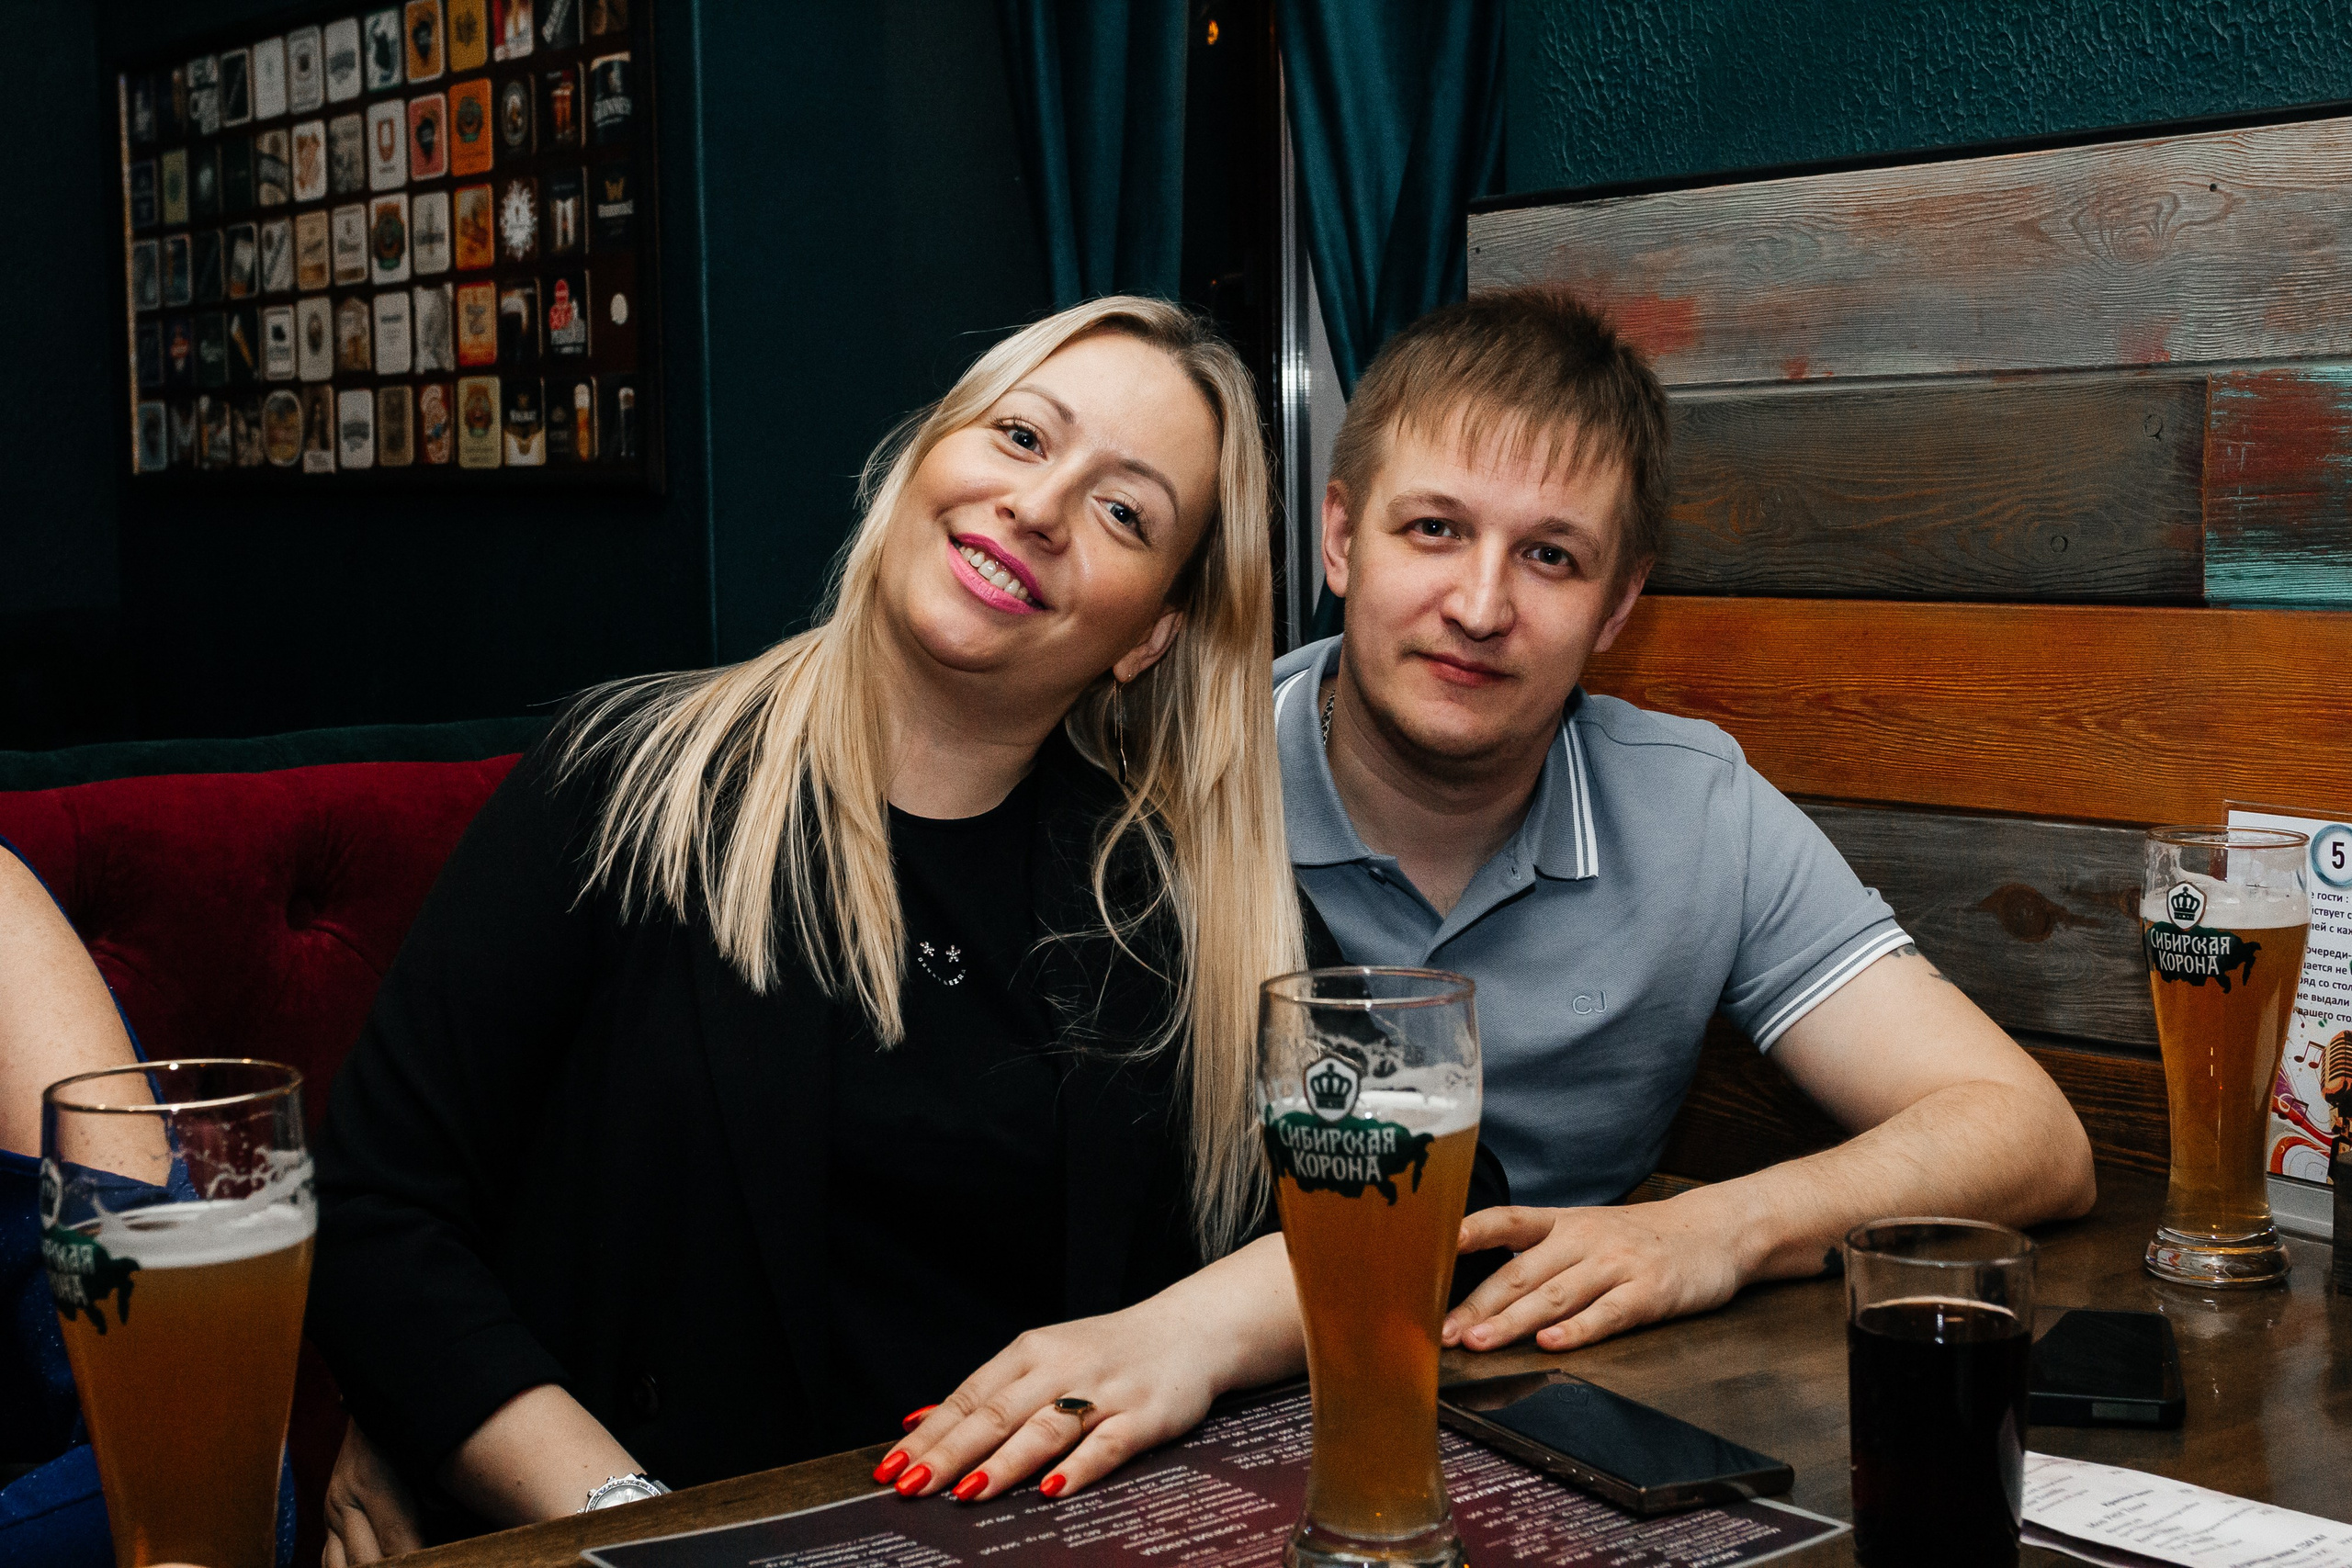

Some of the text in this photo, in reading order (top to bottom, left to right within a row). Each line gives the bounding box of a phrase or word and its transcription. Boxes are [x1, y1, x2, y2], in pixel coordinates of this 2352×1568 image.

[2332, 841, 2345, 869] 5
[2317, 893, 2343, 902] гости
[2151, 928, 2231, 955] СИБИРСКАЯ
[2158, 950, 2220, 976] КОРОНА
[2335, 966, 2347, 975] не
[2318, 979, 2330, 988] со
[1572, 991, 1608, 1015] CJ
[2297, 992, 2350, 1007] не выдали
[1278, 1119, 1396, 1156] СИБИРСКАЯ
[1293, 1150, 1383, 1182] КОРОНА
